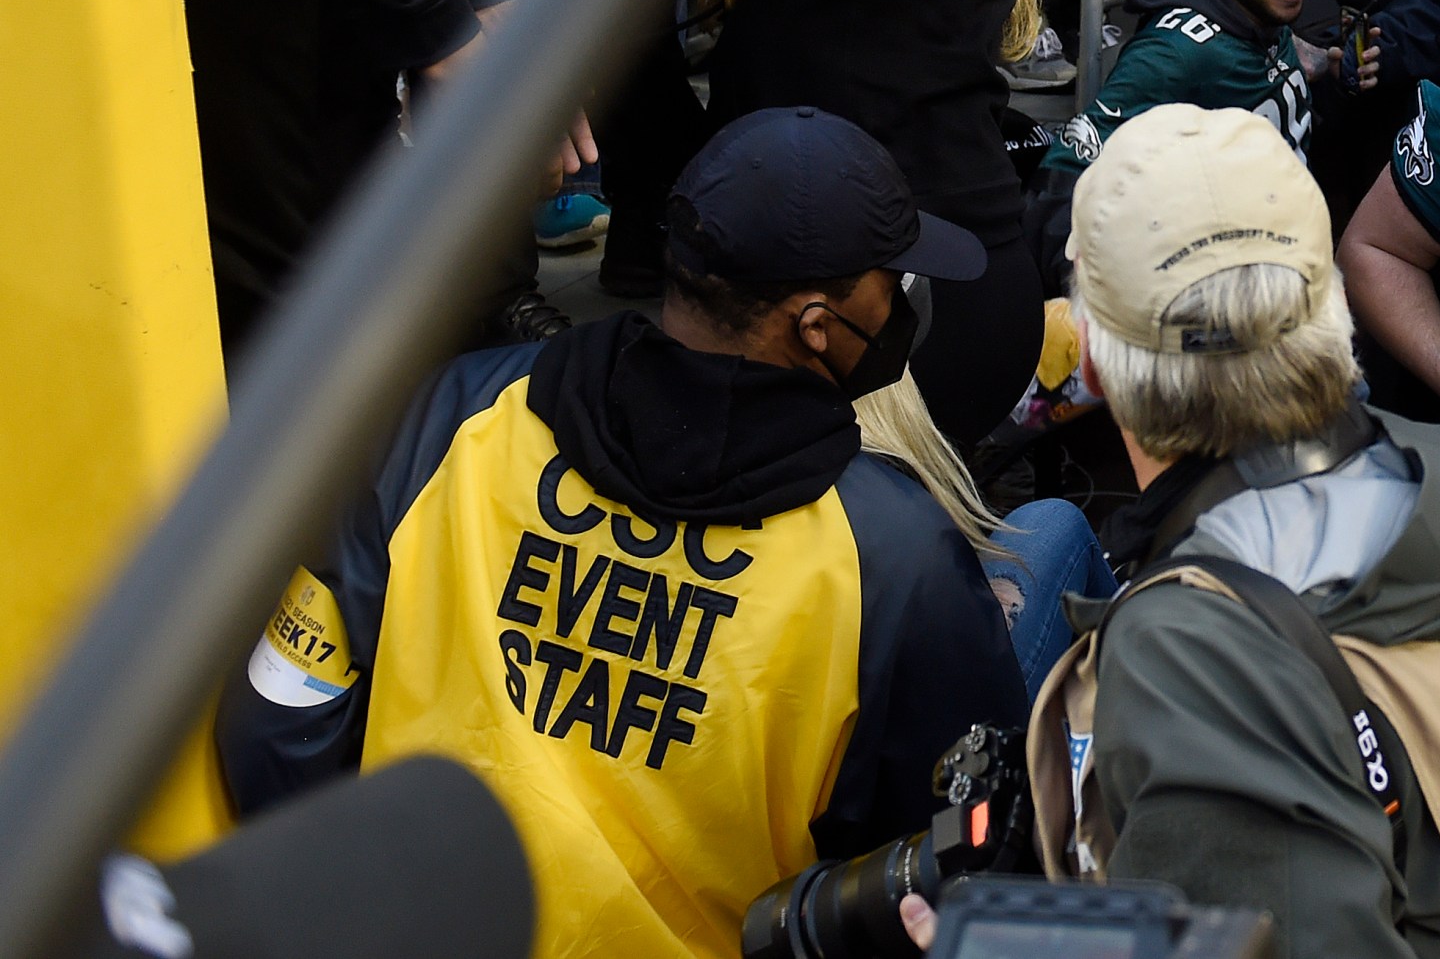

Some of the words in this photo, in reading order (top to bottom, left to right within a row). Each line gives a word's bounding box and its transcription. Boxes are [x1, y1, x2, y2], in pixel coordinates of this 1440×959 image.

[272, 607, 306, 650] EEK
[292, 606, 325, 635] SEASON
[497, 530, 739, 680] EVENT
[498, 629, 708, 770] STAFF
